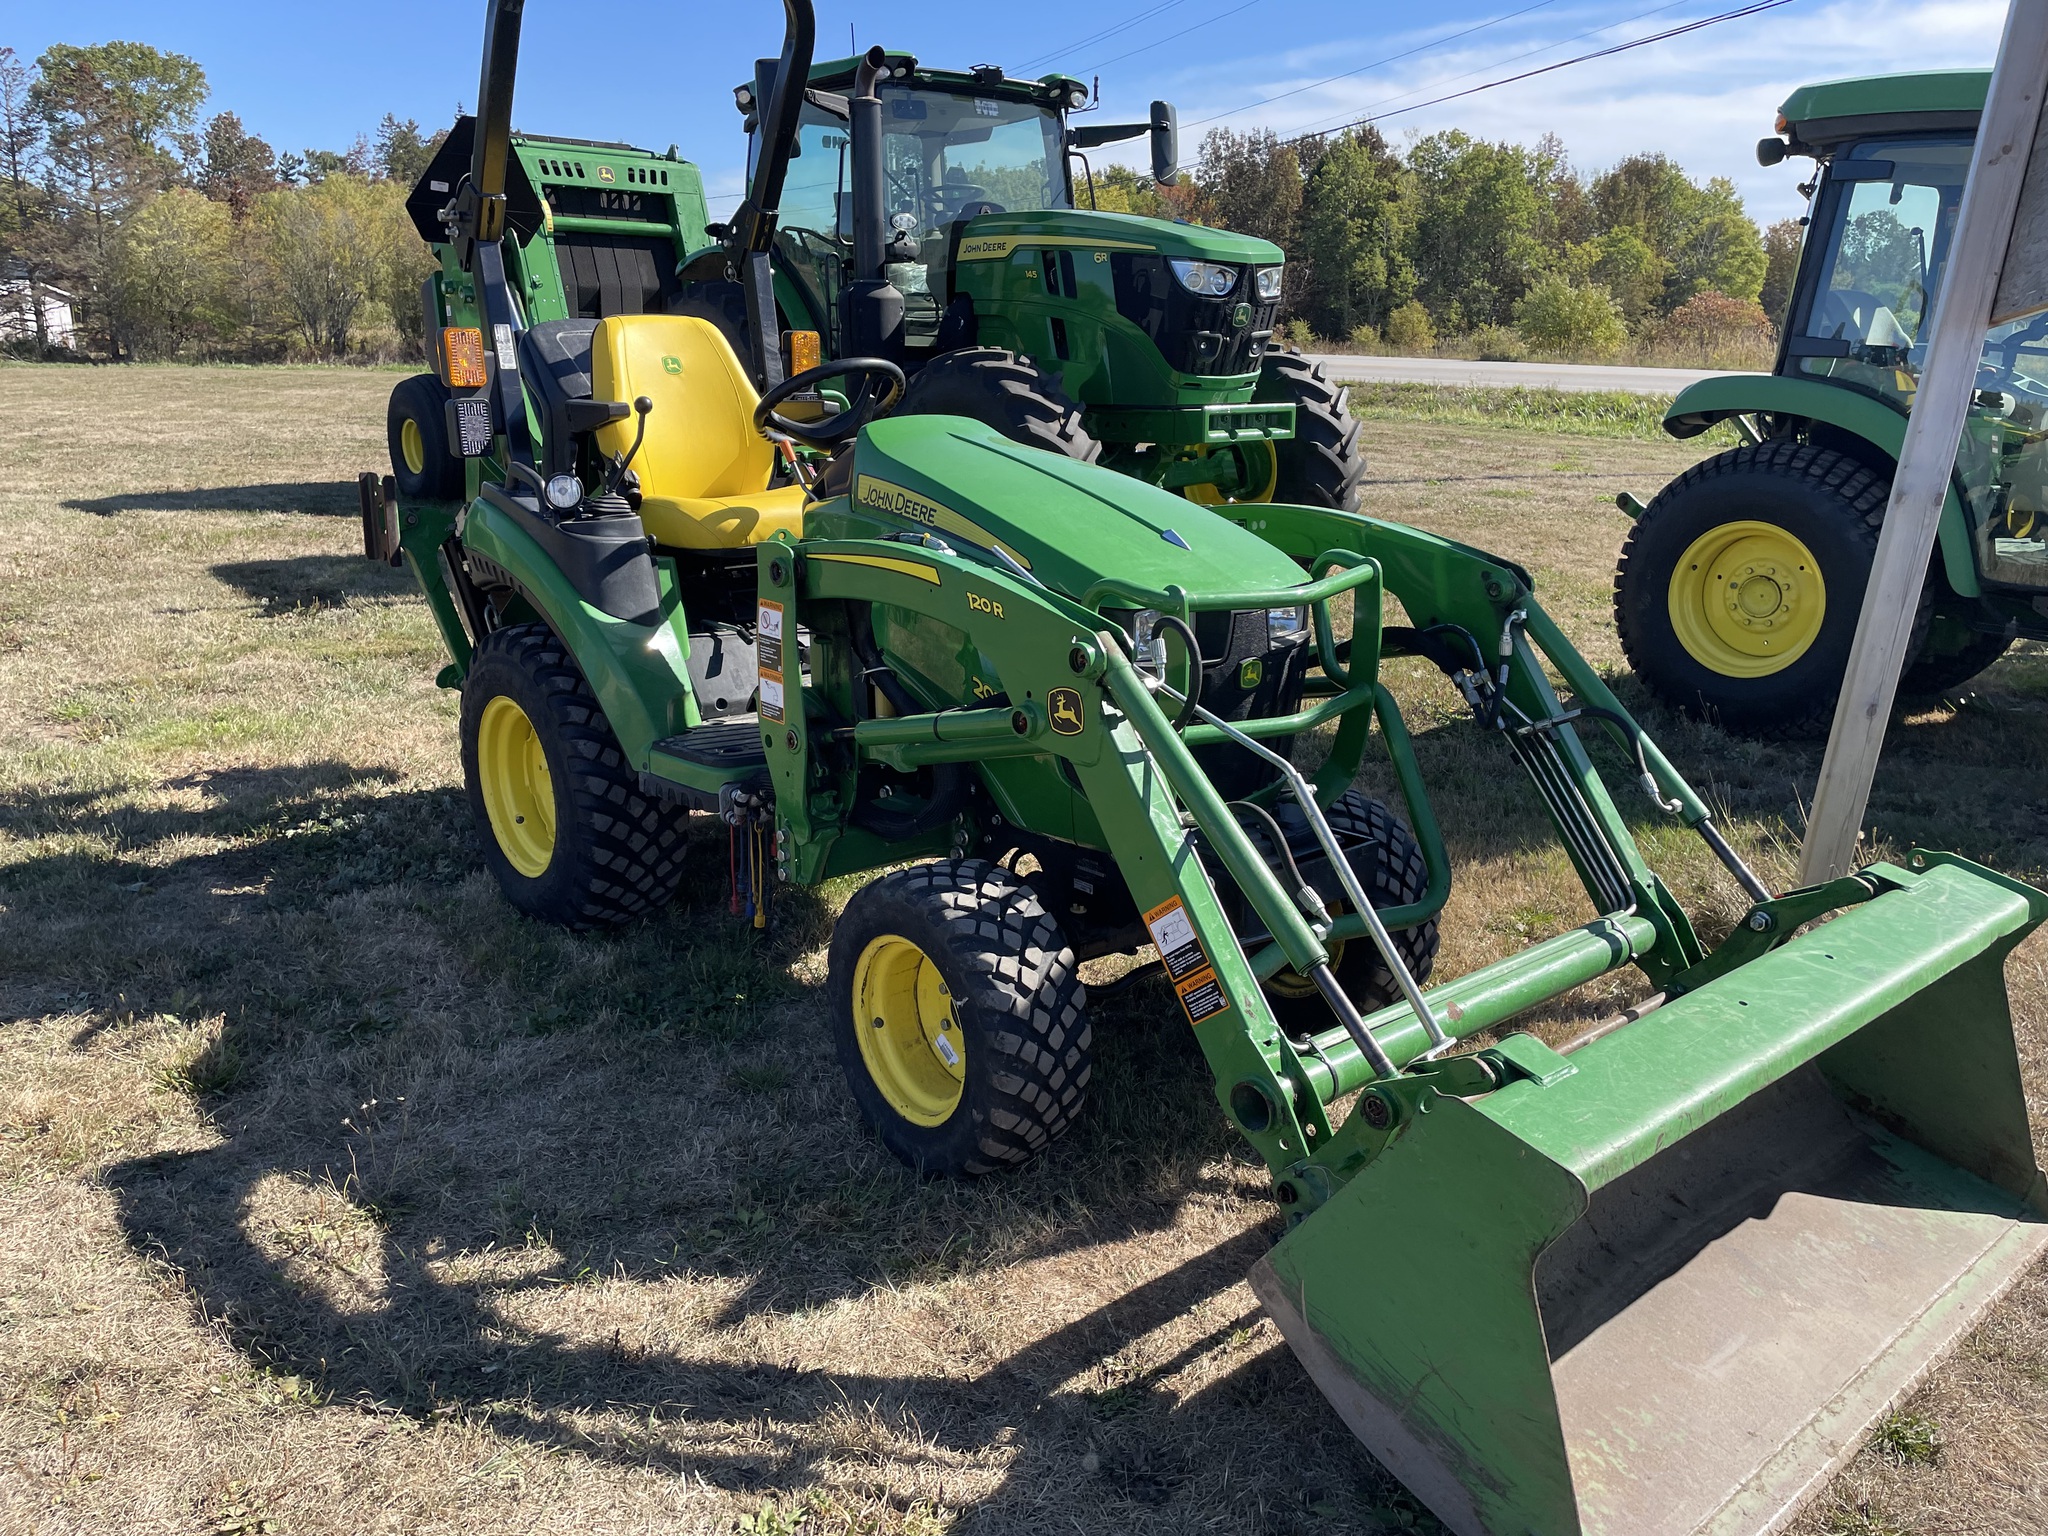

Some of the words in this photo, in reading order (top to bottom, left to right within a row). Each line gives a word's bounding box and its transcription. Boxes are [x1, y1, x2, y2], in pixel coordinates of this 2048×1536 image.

[963, 244, 981, 254] JOHN
[982, 242, 1007, 252] DEERE
[1093, 252, 1108, 264] 6R
[1025, 270, 1038, 279] 145
[863, 484, 894, 509] JOHN
[894, 492, 938, 525] DEERE
[1154, 900, 1178, 918] WARNING
[1187, 972, 1212, 989] WARNING
